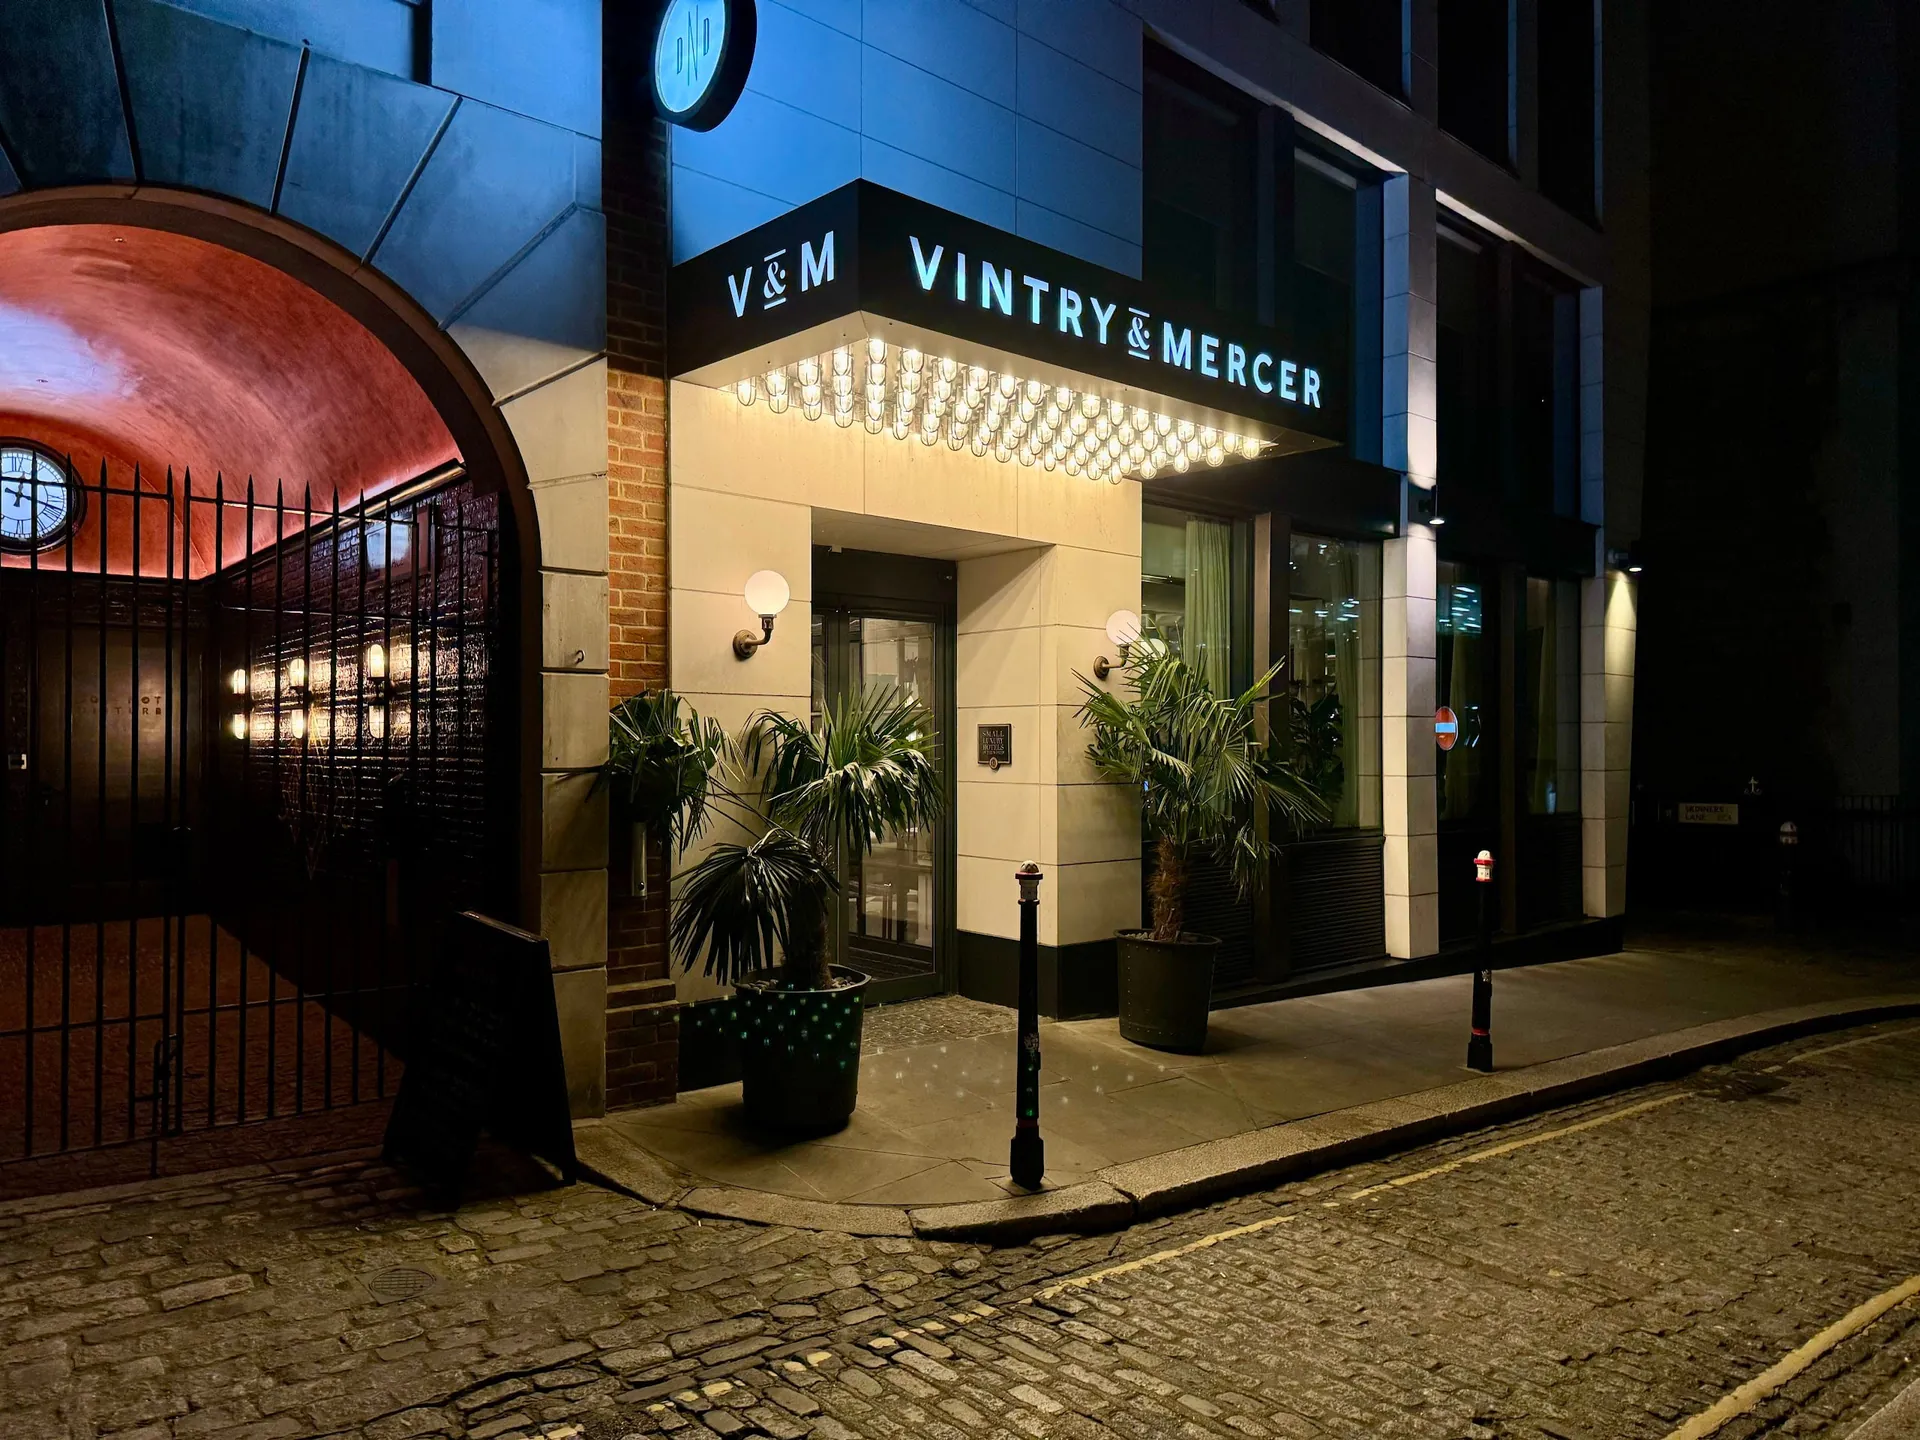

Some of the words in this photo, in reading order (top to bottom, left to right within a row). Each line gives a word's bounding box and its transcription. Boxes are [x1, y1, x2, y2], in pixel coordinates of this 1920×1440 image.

[908, 235, 1116, 345] VINTRY
[1128, 308, 1151, 360] &
[1163, 322, 1322, 409] MERCER
